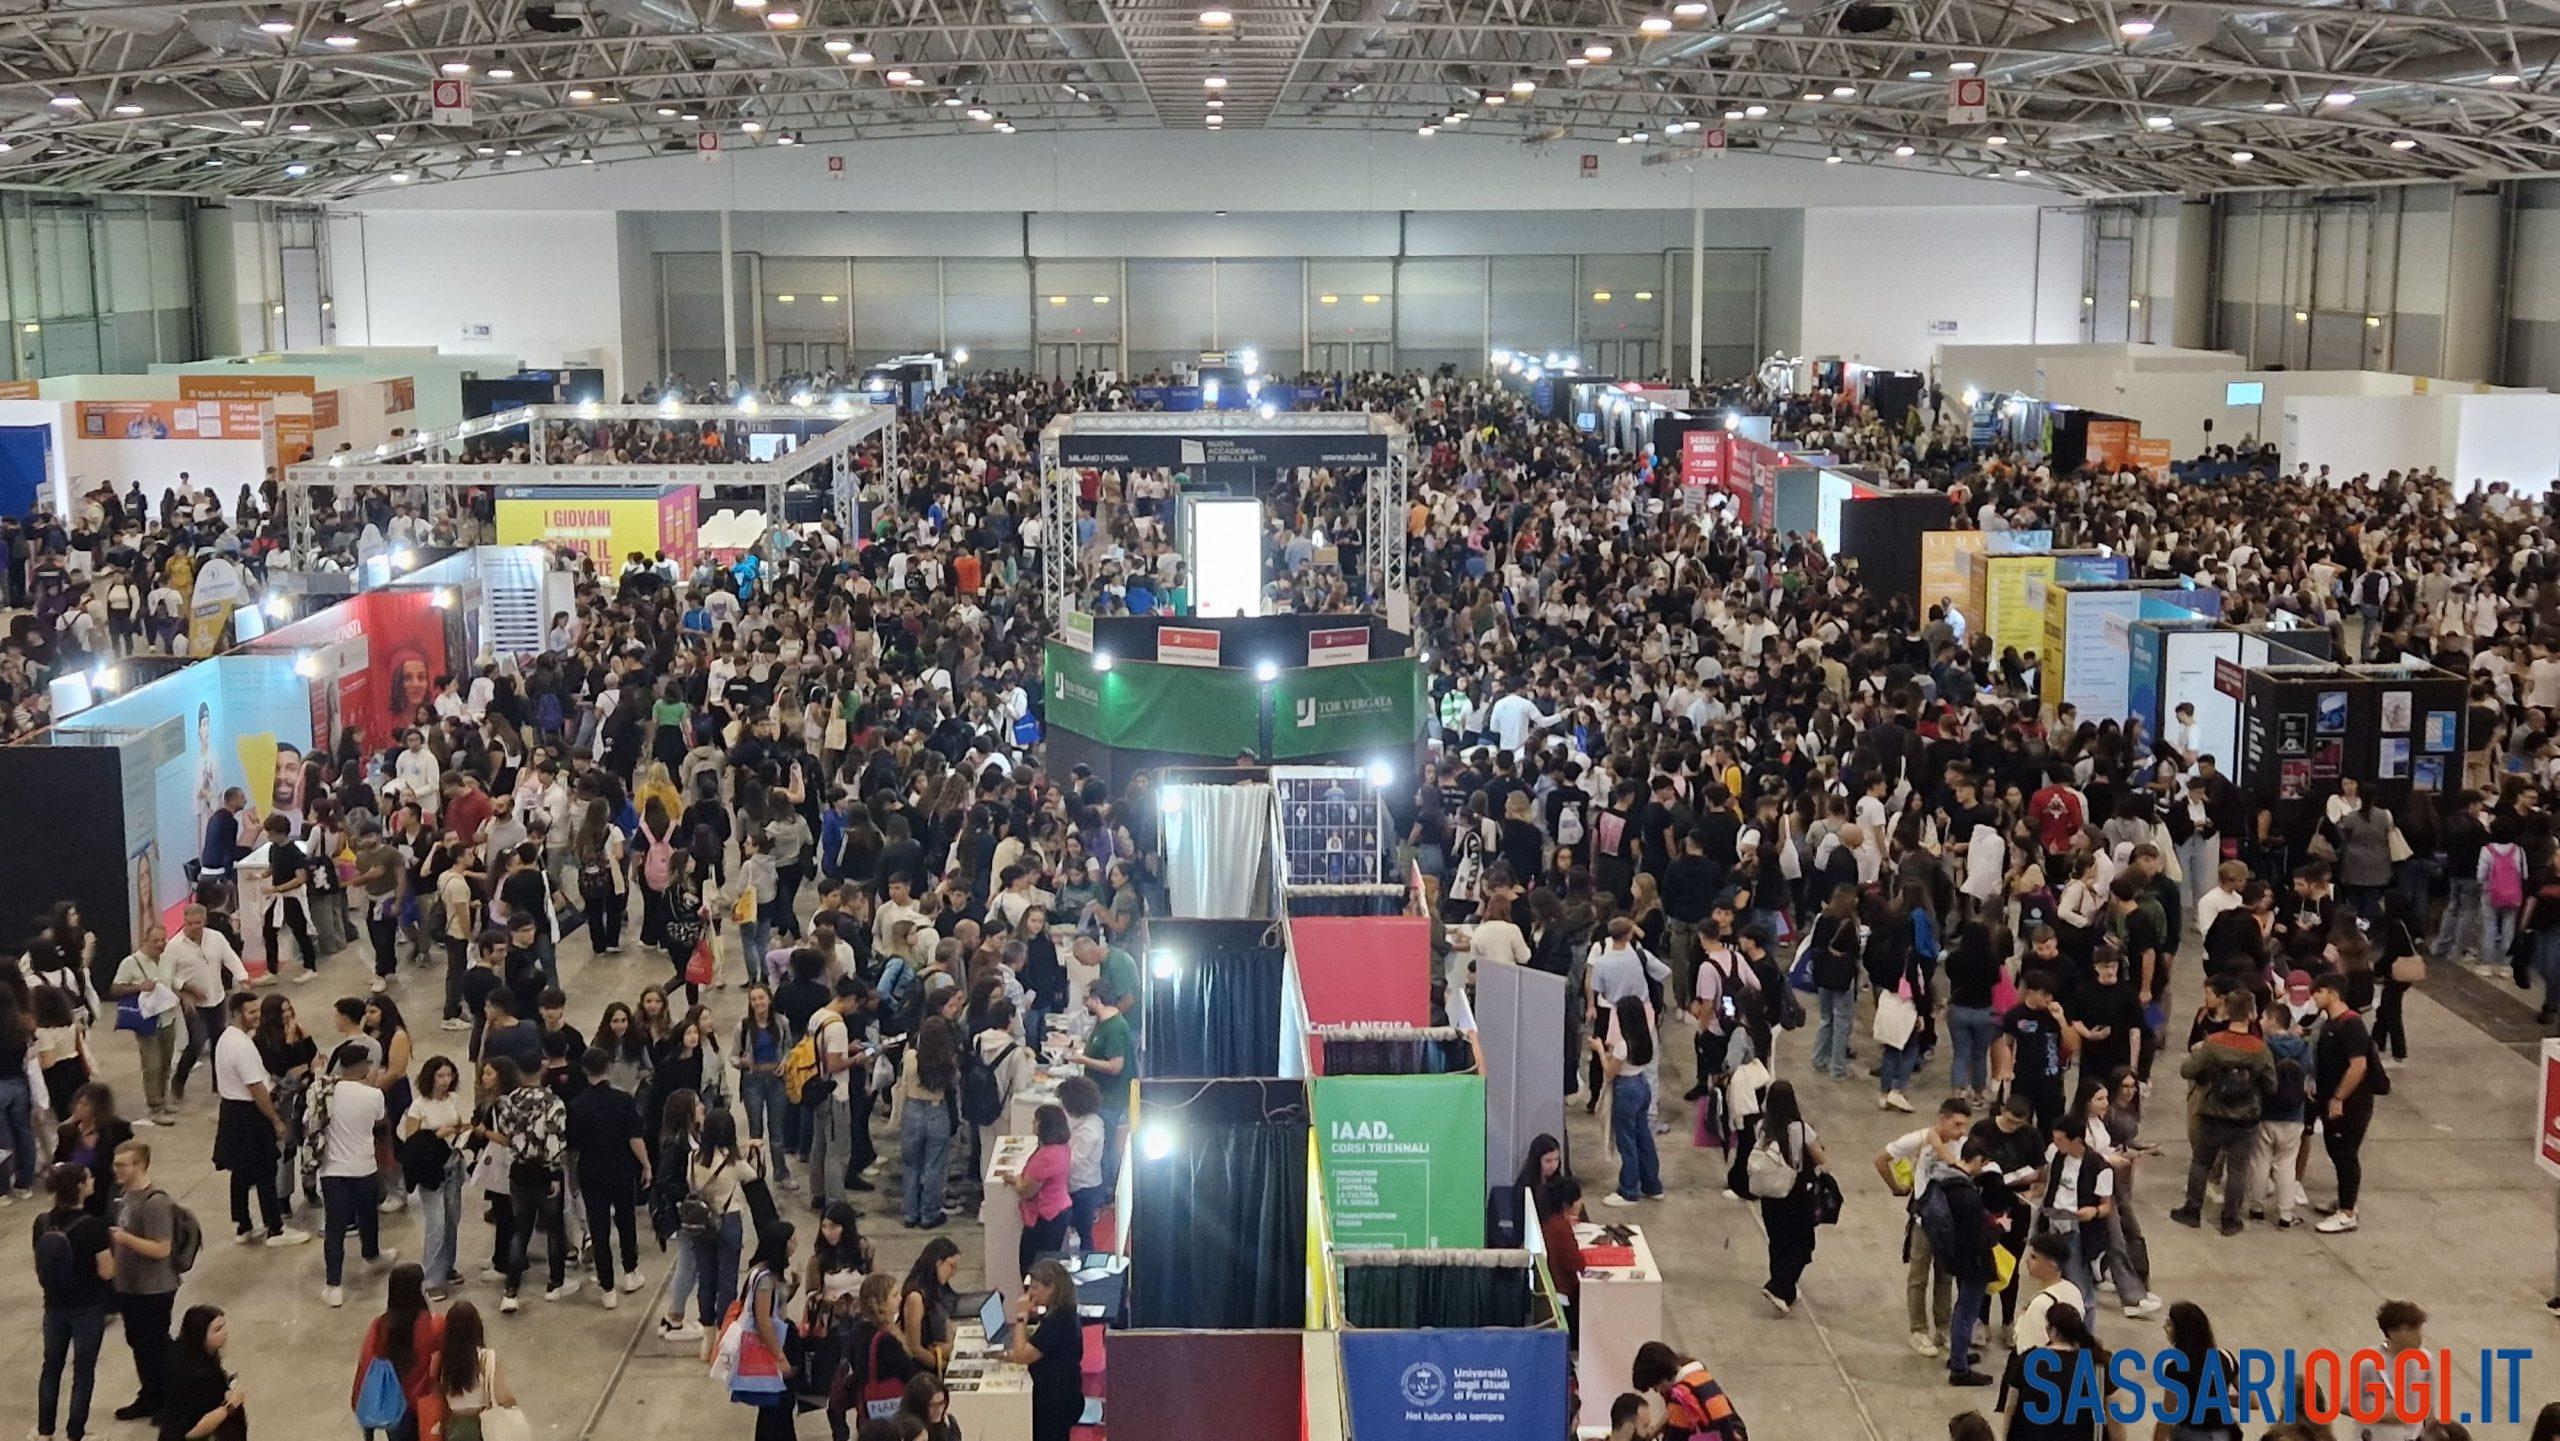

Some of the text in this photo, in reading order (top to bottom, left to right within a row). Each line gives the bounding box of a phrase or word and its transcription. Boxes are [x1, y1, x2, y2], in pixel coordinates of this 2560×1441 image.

[198, 390, 216, 398] tuo
[217, 389, 250, 398] futuro
[1068, 454, 1099, 462] MILANO
[1105, 454, 1130, 462] ROMA
[544, 509, 611, 528] I GIOVANI
[597, 539, 611, 559] IL
[1319, 701, 1341, 713] TOR
[1342, 696, 1392, 710] VERGATA
[1309, 1020, 1345, 1033] Corsi
[1332, 1121, 1394, 1139] IAAD.
[1332, 1142, 1430, 1153] CORSI TRIENNALI
[1453, 1367, 1508, 1378] Università
[1453, 1379, 1510, 1391] degli Studi
[1453, 1391, 1505, 1401] di Ferrara
[1405, 1411, 1505, 1422] Nel futuro da sempre
